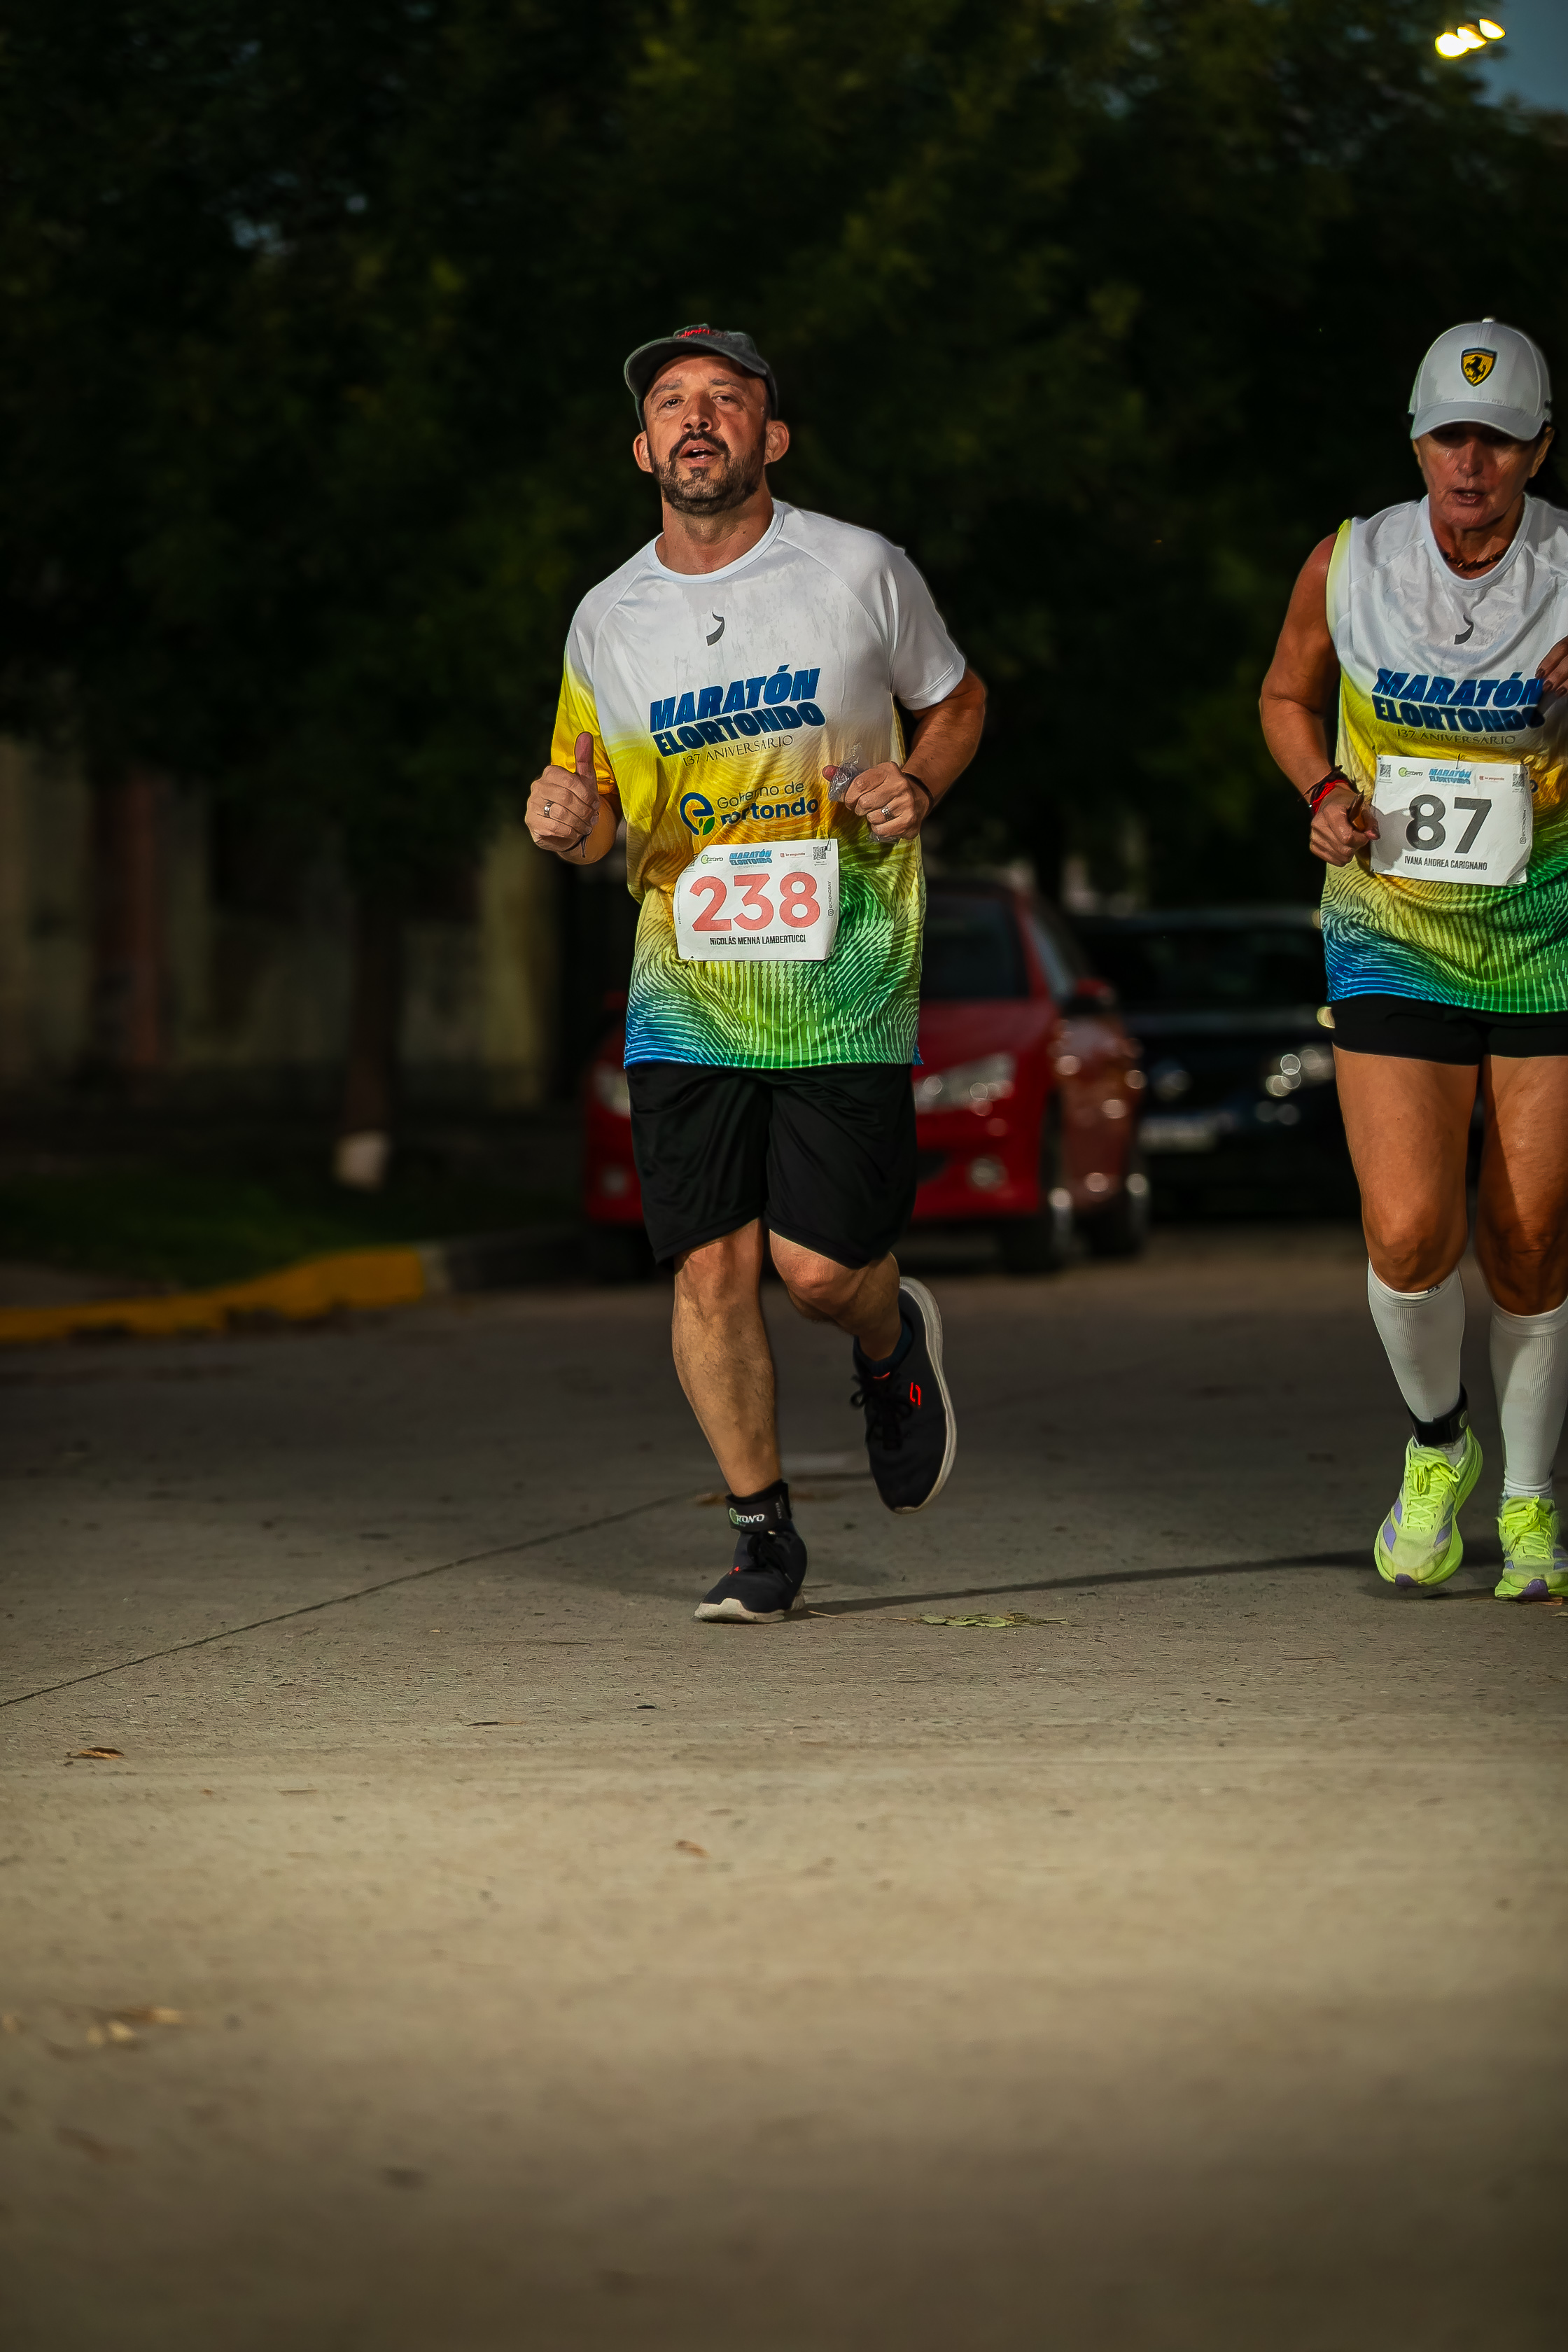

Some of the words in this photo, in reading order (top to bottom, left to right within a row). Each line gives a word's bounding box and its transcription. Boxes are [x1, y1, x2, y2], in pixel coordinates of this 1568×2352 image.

[650, 664, 820, 733] MARATÓN
[1372, 668, 1544, 708] MARATÓN
[652, 701, 826, 757] ELORTONDO
[1372, 694, 1546, 733] ELORTONDO
[682, 753, 700, 766] 137
[706, 735, 793, 762] ANIVERSARIO
[1397, 728, 1415, 737] 137
[1420, 732, 1516, 744] ANIVERSARIO
[784, 781, 804, 794] de
[1429, 768, 1472, 778] MARATÓN
[1406, 794, 1492, 854] 87
[729, 848, 773, 860] MARATÓN
[1404, 855, 1422, 866] IVANA
[1424, 858, 1449, 868] ANDREA
[1450, 860, 1488, 871] CARIGNANO
[689, 871, 820, 932] 238
[710, 934, 736, 945] NICOLÁS
[738, 936, 760, 945] MENNA
[762, 934, 806, 944] LAMBERTUCCI
